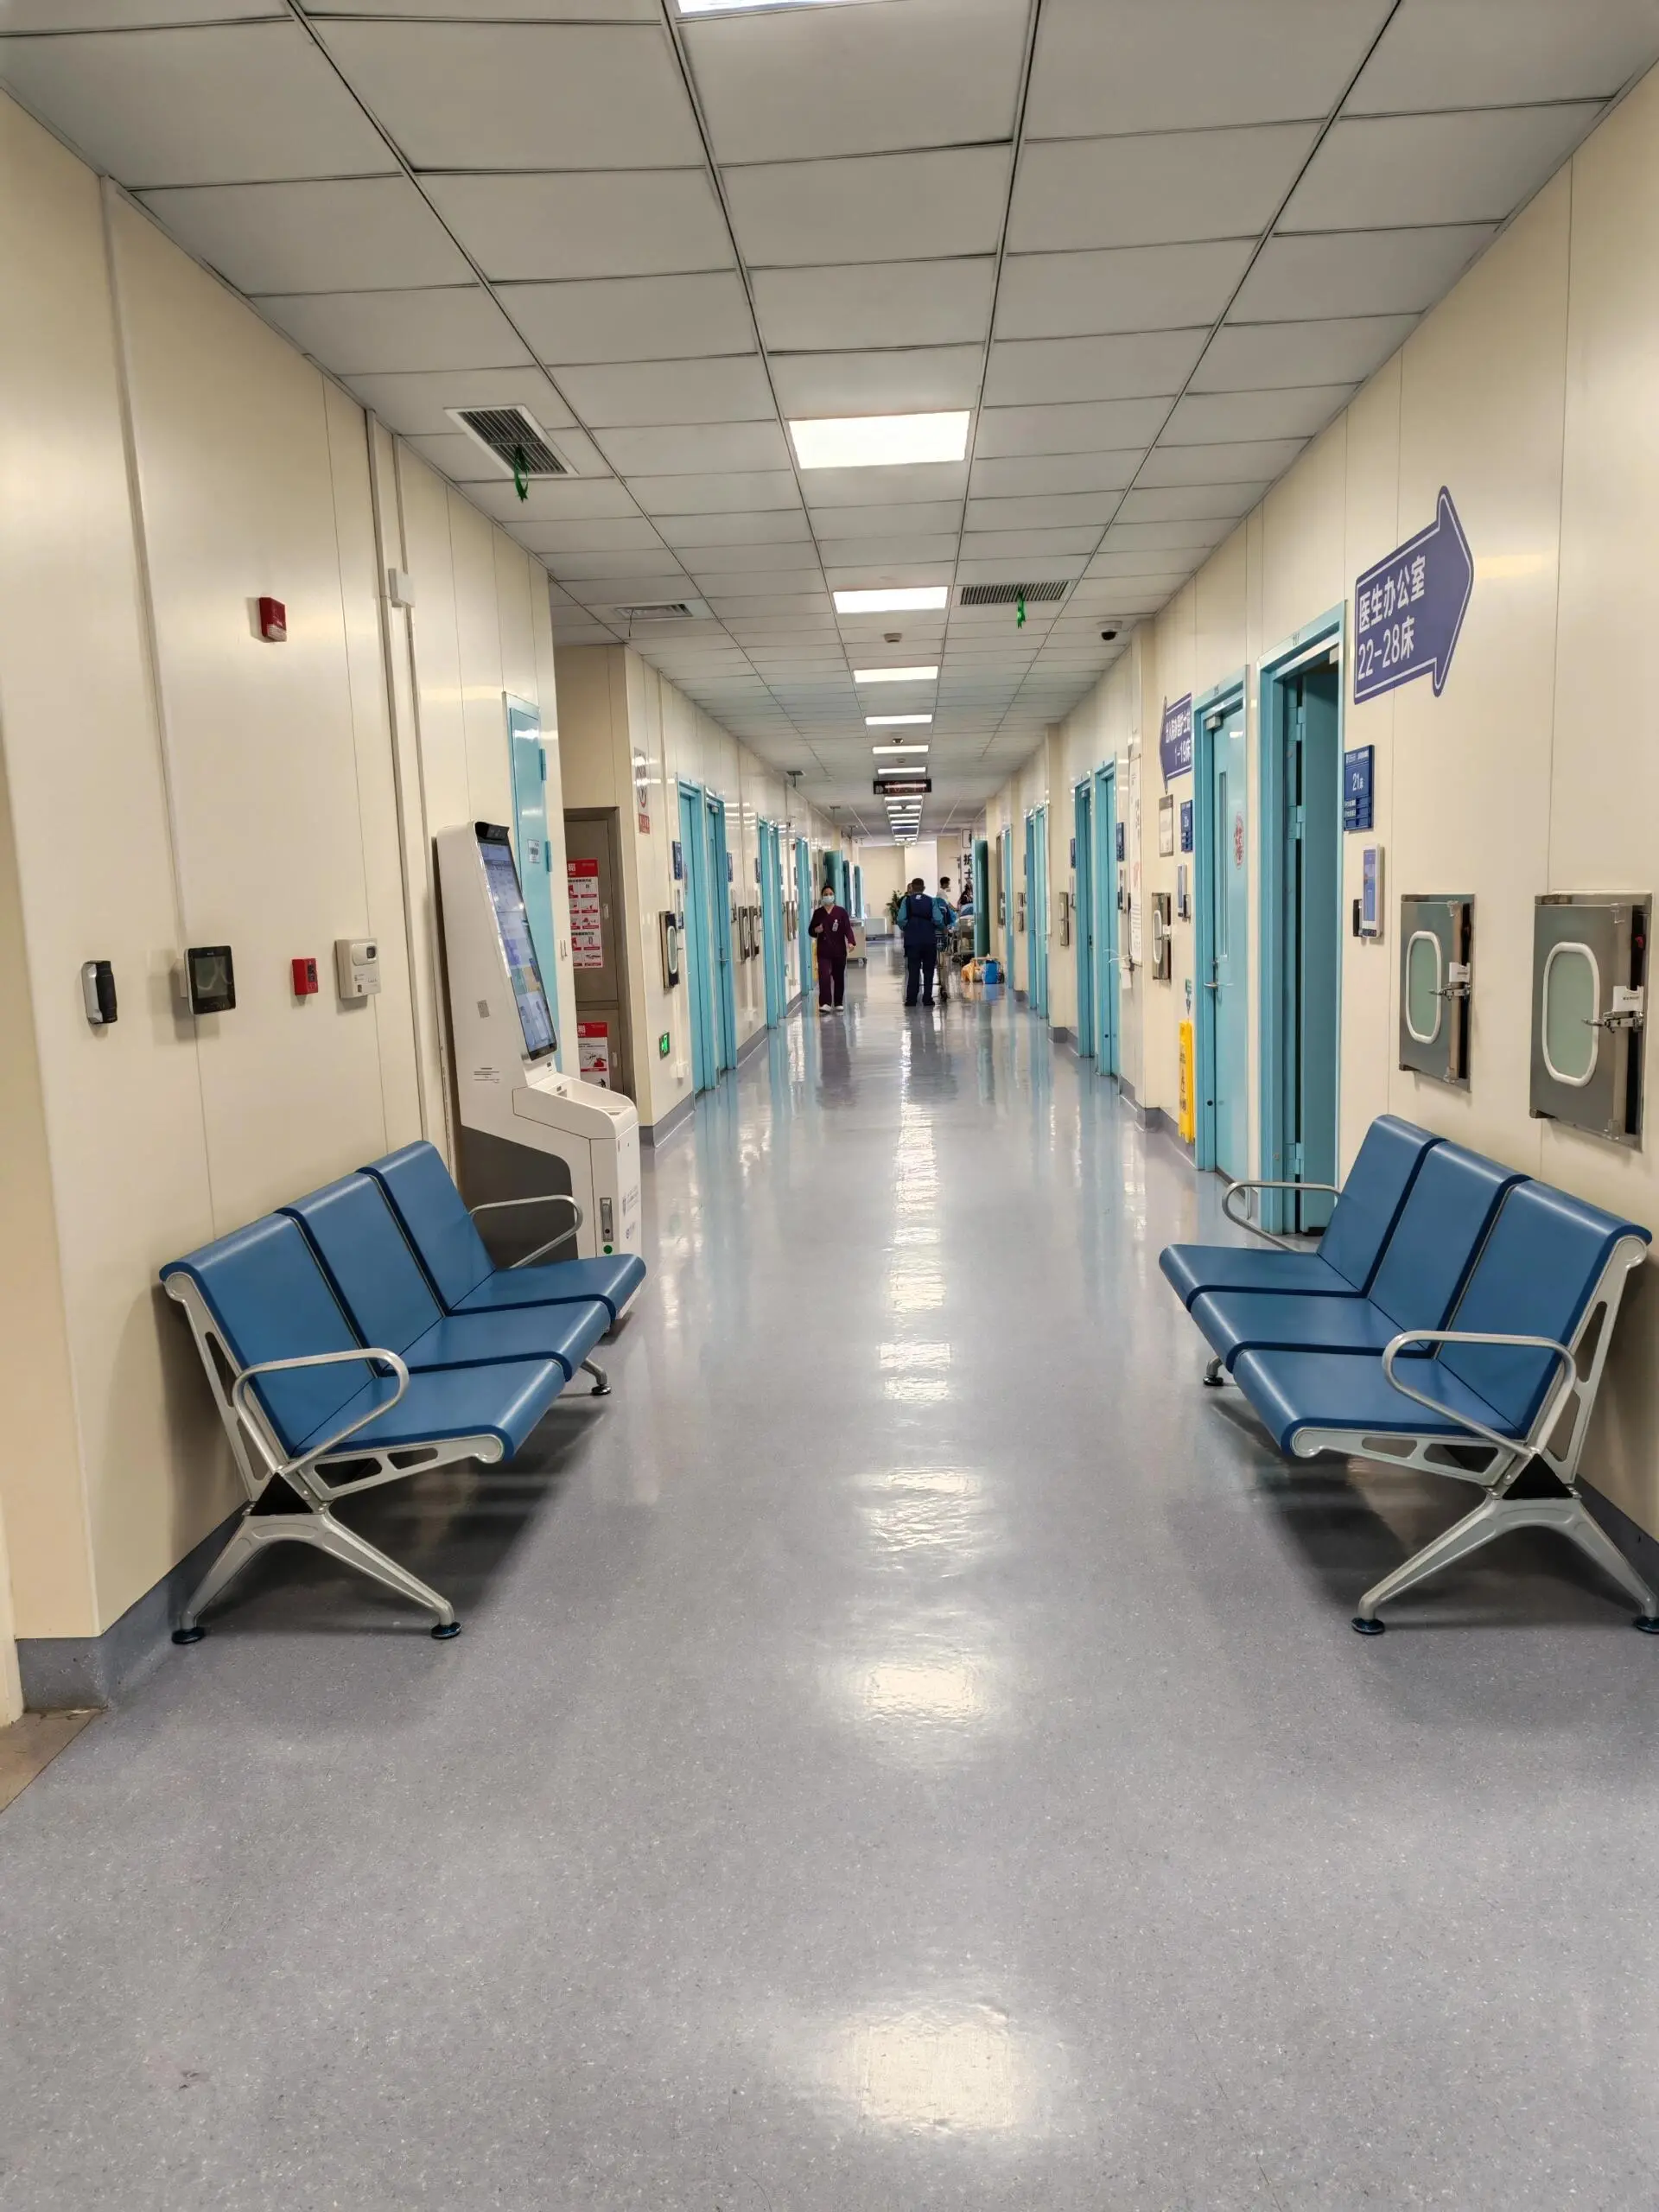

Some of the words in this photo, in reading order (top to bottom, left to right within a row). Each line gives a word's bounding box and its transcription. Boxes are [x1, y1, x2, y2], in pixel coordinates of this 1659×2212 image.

[1359, 555, 1426, 633] 医生办公室
[1357, 614, 1415, 681] 22-28床
[1174, 737, 1191, 766] 1-19床
